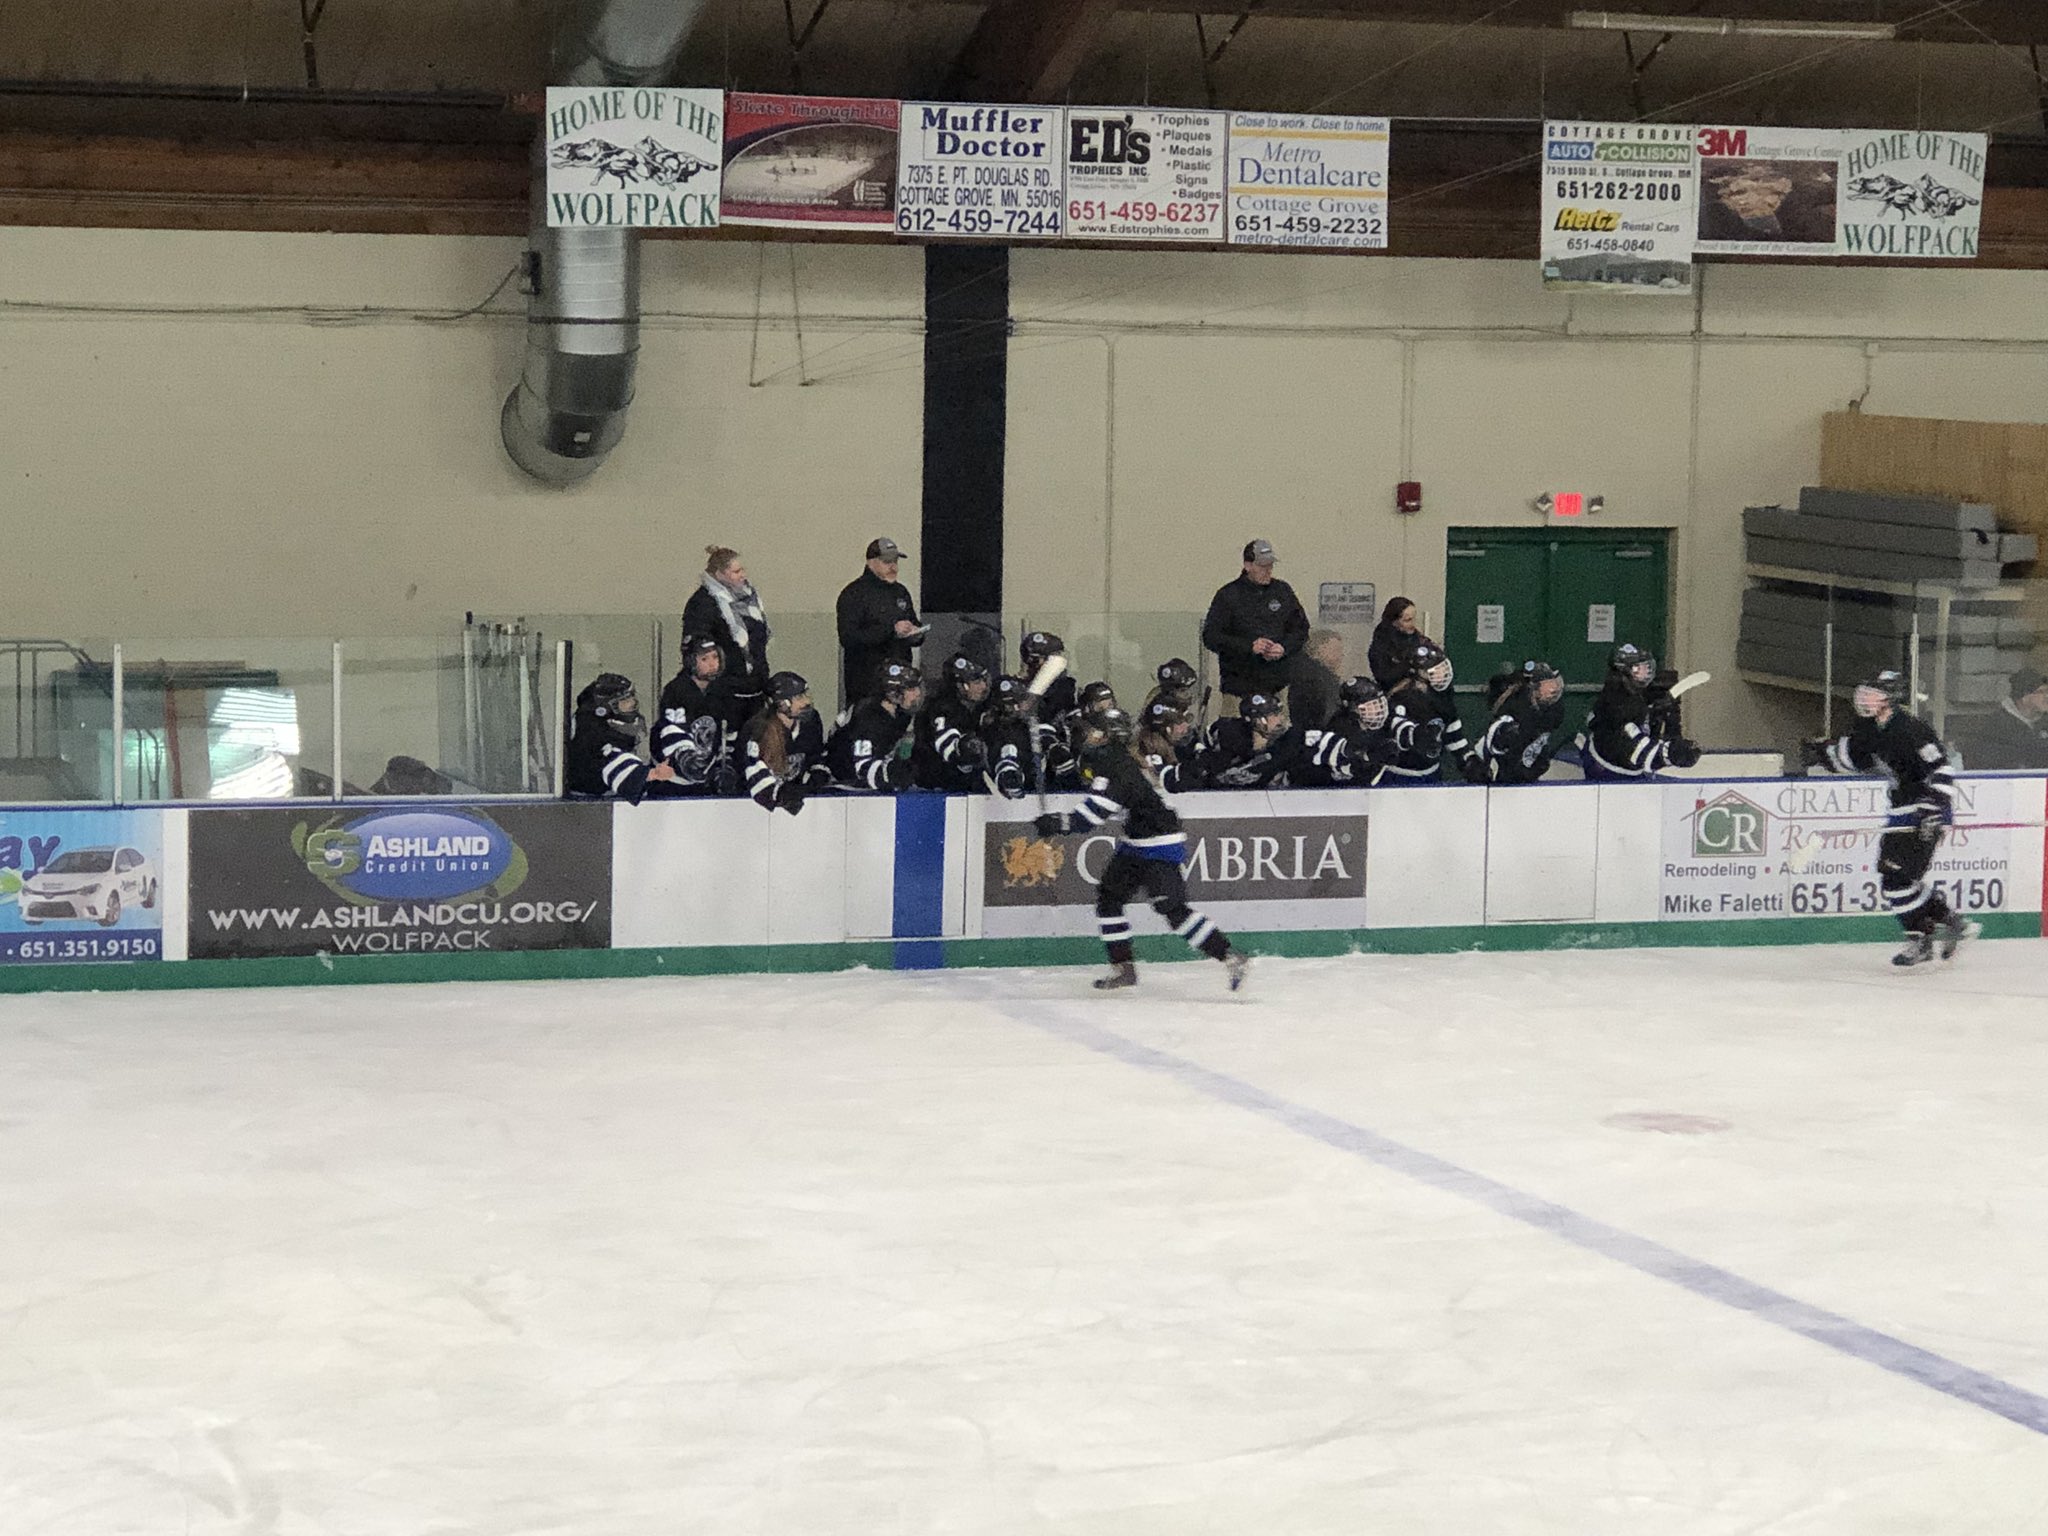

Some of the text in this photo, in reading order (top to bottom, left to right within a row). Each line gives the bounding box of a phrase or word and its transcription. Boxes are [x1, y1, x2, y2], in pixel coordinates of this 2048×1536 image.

[550, 89, 721, 144] HOME OF THE
[735, 100, 896, 122] Skate Through Life
[921, 107, 1043, 133] Muffler
[1157, 114, 1210, 129] Trophies
[1235, 115, 1263, 128] Close
[1267, 116, 1278, 128] to
[1312, 116, 1340, 129] Close
[1344, 119, 1353, 130] to
[1163, 129, 1211, 144] Plaques
[1548, 126, 1691, 141] COTTAGE GROVE
[1697, 128, 1747, 157] 3M
[937, 132, 1046, 157] Doctor
[1169, 145, 1212, 156] Medals
[1262, 141, 1321, 163] Metro
[1551, 145, 1590, 158] AUTO
[1607, 146, 1688, 161] COLLISION
[1172, 160, 1211, 171] Plastic
[1848, 132, 1983, 181] HOME OF THE
[908, 165, 933, 184] 7375
[975, 167, 1029, 186] DOUGLAS
[1034, 169, 1053, 187] RD.
[1069, 165, 1123, 175] TROPHIES
[1175, 174, 1208, 187] Signs
[1238, 157, 1381, 187] Dentalcare
[899, 186, 949, 206] COTTAGE
[1026, 190, 1061, 208] 55016
[1178, 189, 1222, 201] Badges
[1557, 180, 1681, 201] 651-262-2000
[552, 193, 719, 226] WOLFPACK
[1069, 200, 1220, 222] 651-459-6237
[1236, 195, 1379, 215] Cottage Grove
[898, 207, 1060, 234] 612-459-7244
[1078, 224, 1209, 236] www.Edstrophies.com
[1235, 215, 1382, 234] 651-459-2232
[1554, 207, 1680, 232] Hertz Rental Cars
[1234, 233, 1381, 247] metro-dentalcare.com
[1567, 238, 1654, 251] 651-458-0840
[1844, 224, 1977, 255] WOLFPACK
[367, 836, 490, 858] ASHLAND
[365, 859, 490, 873] Credit Union
[1075, 834, 1352, 885] CMBRIA
[1665, 863, 1756, 879] Remodeling
[1665, 894, 1712, 913] Mike
[1720, 893, 1783, 912] Faletti
[208, 900, 599, 931] WWW.ASHLANDCU.ORG/
[20, 939, 156, 957] 651.351.9150
[331, 930, 492, 953] WOLFPACK
